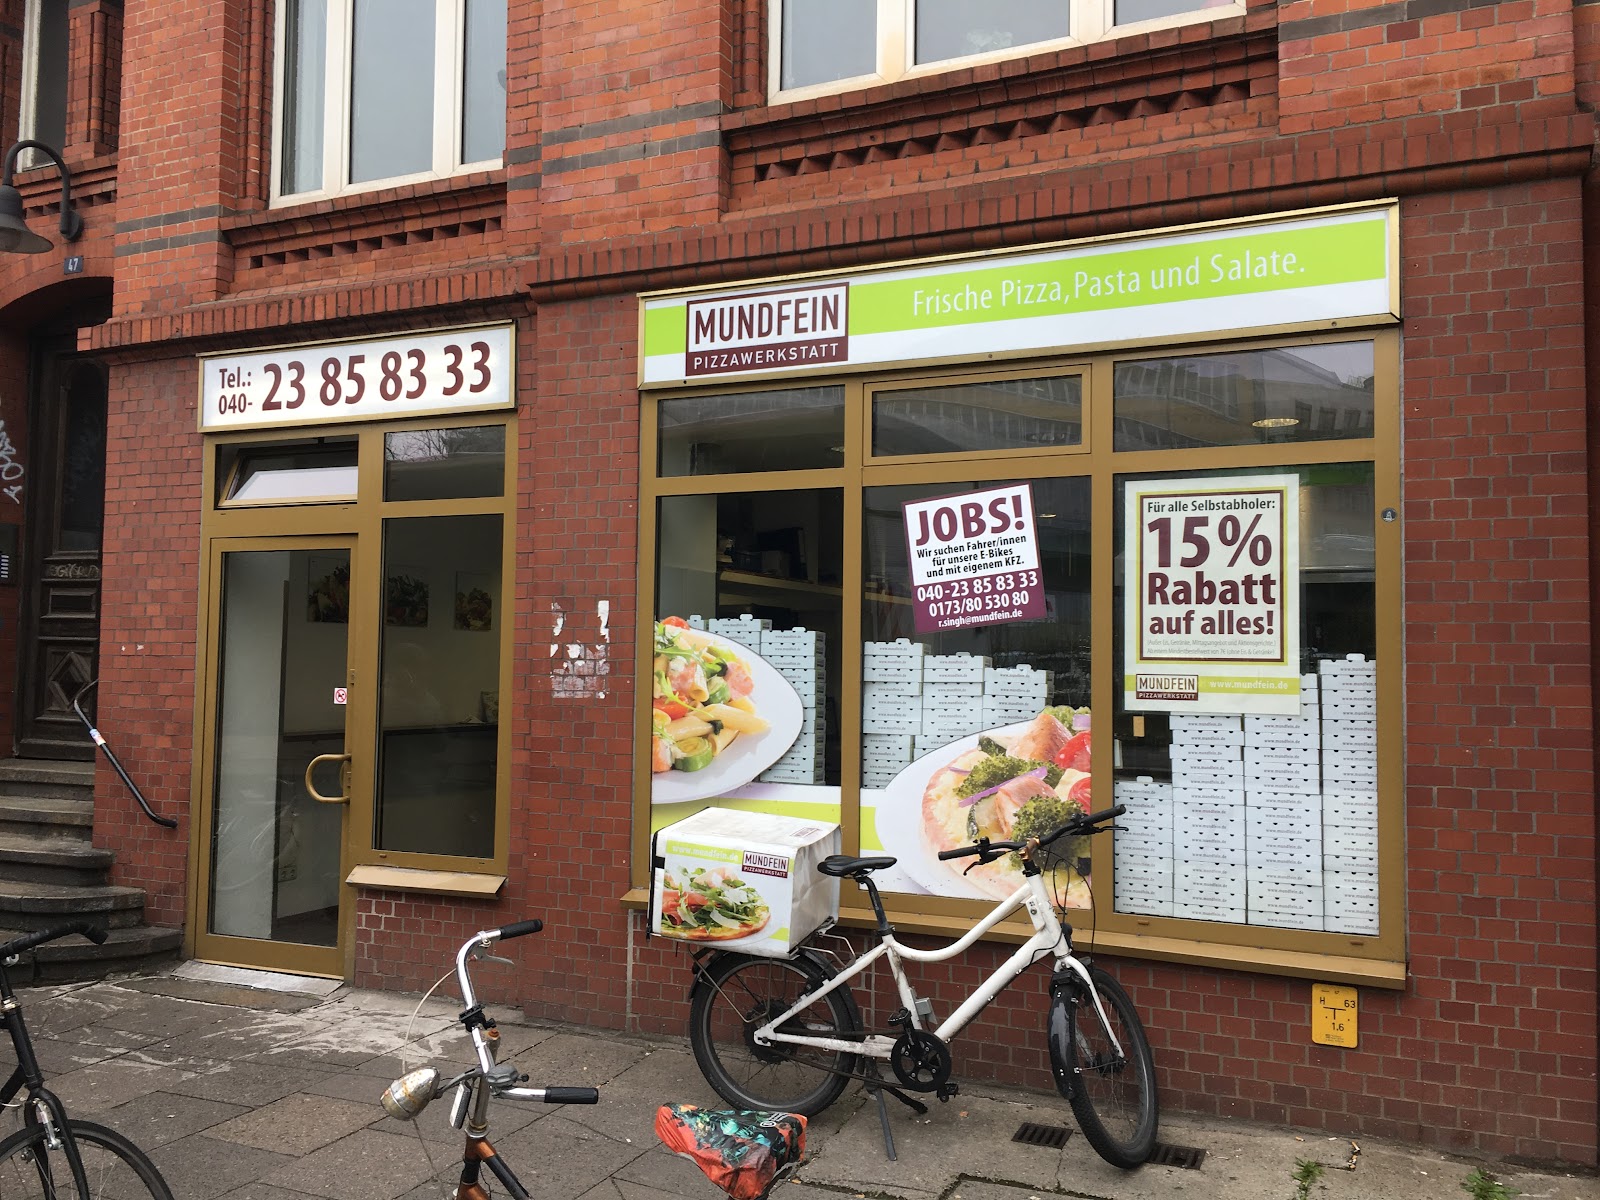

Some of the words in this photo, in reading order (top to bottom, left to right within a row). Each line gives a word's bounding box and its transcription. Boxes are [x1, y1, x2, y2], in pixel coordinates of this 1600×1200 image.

[68, 258, 79, 271] 47
[913, 284, 993, 316] Frische
[1001, 278, 1070, 306] Pizza,
[1075, 271, 1141, 299] Pasta
[1151, 257, 1200, 290] und
[1210, 249, 1306, 284] Salate.
[695, 294, 839, 345] MUNDFEIN
[694, 343, 839, 370] PIZZAWERKSTATT
[218, 393, 253, 415] 040-
[262, 360, 305, 411] 23
[319, 354, 366, 406] 85
[379, 349, 427, 401] 83
[442, 341, 492, 396] 33
[219, 367, 252, 389] Tel.:
[1147, 501, 1165, 513] Für
[1168, 500, 1189, 512] alle
[1191, 498, 1276, 512] Selbstabholer:
[915, 494, 1025, 547] JOBS!
[917, 549, 932, 558] Wir
[934, 543, 965, 556] suchen
[967, 535, 1027, 552] Fahrer/innen
[1147, 513, 1272, 568] 15%
[926, 567, 944, 578] und
[946, 565, 961, 575] mit
[963, 561, 1003, 573] eigenem
[1005, 556, 1025, 567] KFZ.
[932, 557, 946, 567] für
[948, 553, 978, 564] unsere
[980, 548, 1013, 560] E-Bikes
[973, 577, 992, 594] 85
[995, 574, 1014, 591] 83
[1018, 571, 1038, 588] 33
[1148, 571, 1276, 605] Rabatt
[929, 598, 982, 617] 0173/80
[985, 593, 1010, 610] 530
[1012, 590, 1029, 606] 80
[938, 609, 1023, 628] r.singh@mundfein.de
[1149, 609, 1195, 635] auf
[1200, 609, 1274, 635] alles!
[1139, 676, 1195, 691] MUNDFEIN
[1209, 681, 1289, 690] www.mundfein.de
[1139, 692, 1195, 700] PIZZAWERKSTATT
[672, 844, 739, 863] www.mundfein.de
[744, 853, 787, 870] MUNDFEIN
[1320, 996, 1326, 1005] H
[1344, 999, 1356, 1009] 63
[1332, 1022, 1344, 1032] 1.6
